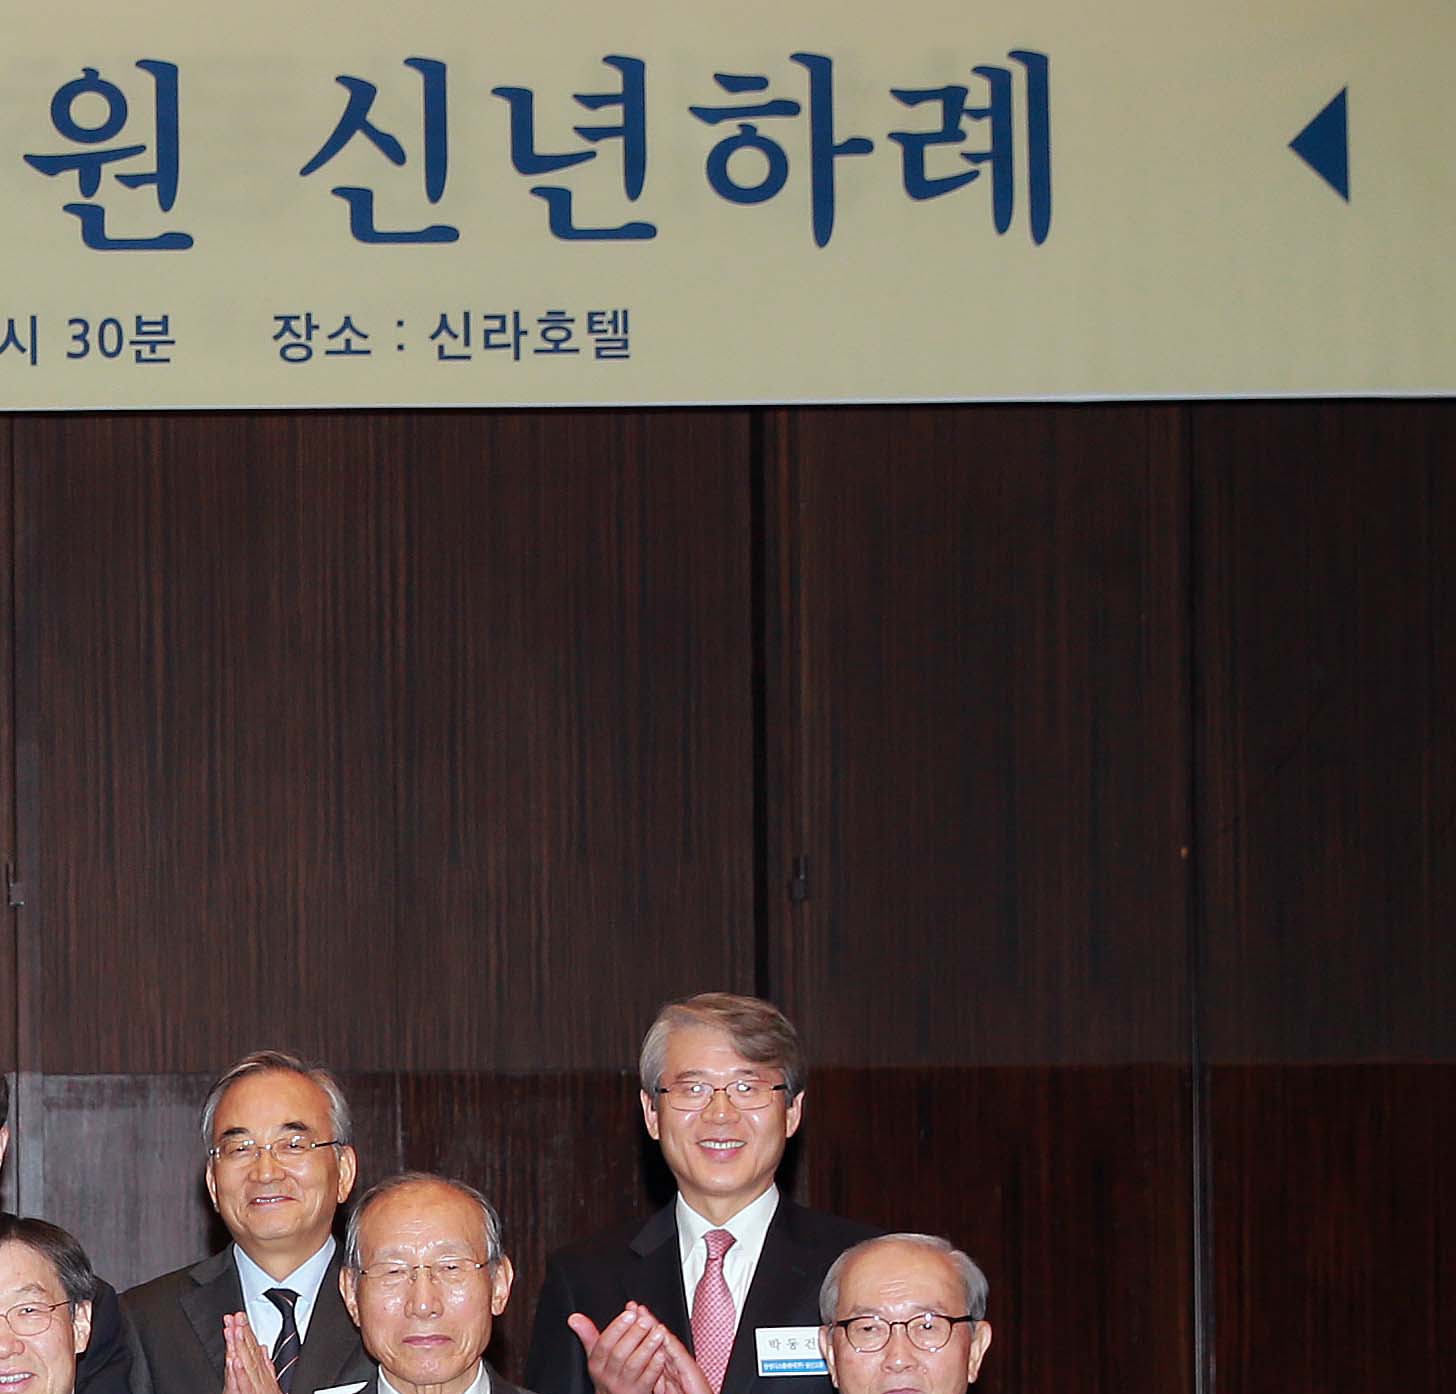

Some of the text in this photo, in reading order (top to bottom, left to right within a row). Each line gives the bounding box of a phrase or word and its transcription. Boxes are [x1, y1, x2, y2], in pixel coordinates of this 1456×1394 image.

[300, 49, 1052, 248] 신년하례
[67, 315, 175, 363] 30분
[273, 313, 371, 363] 장소
[430, 309, 630, 361] 신라호텔
